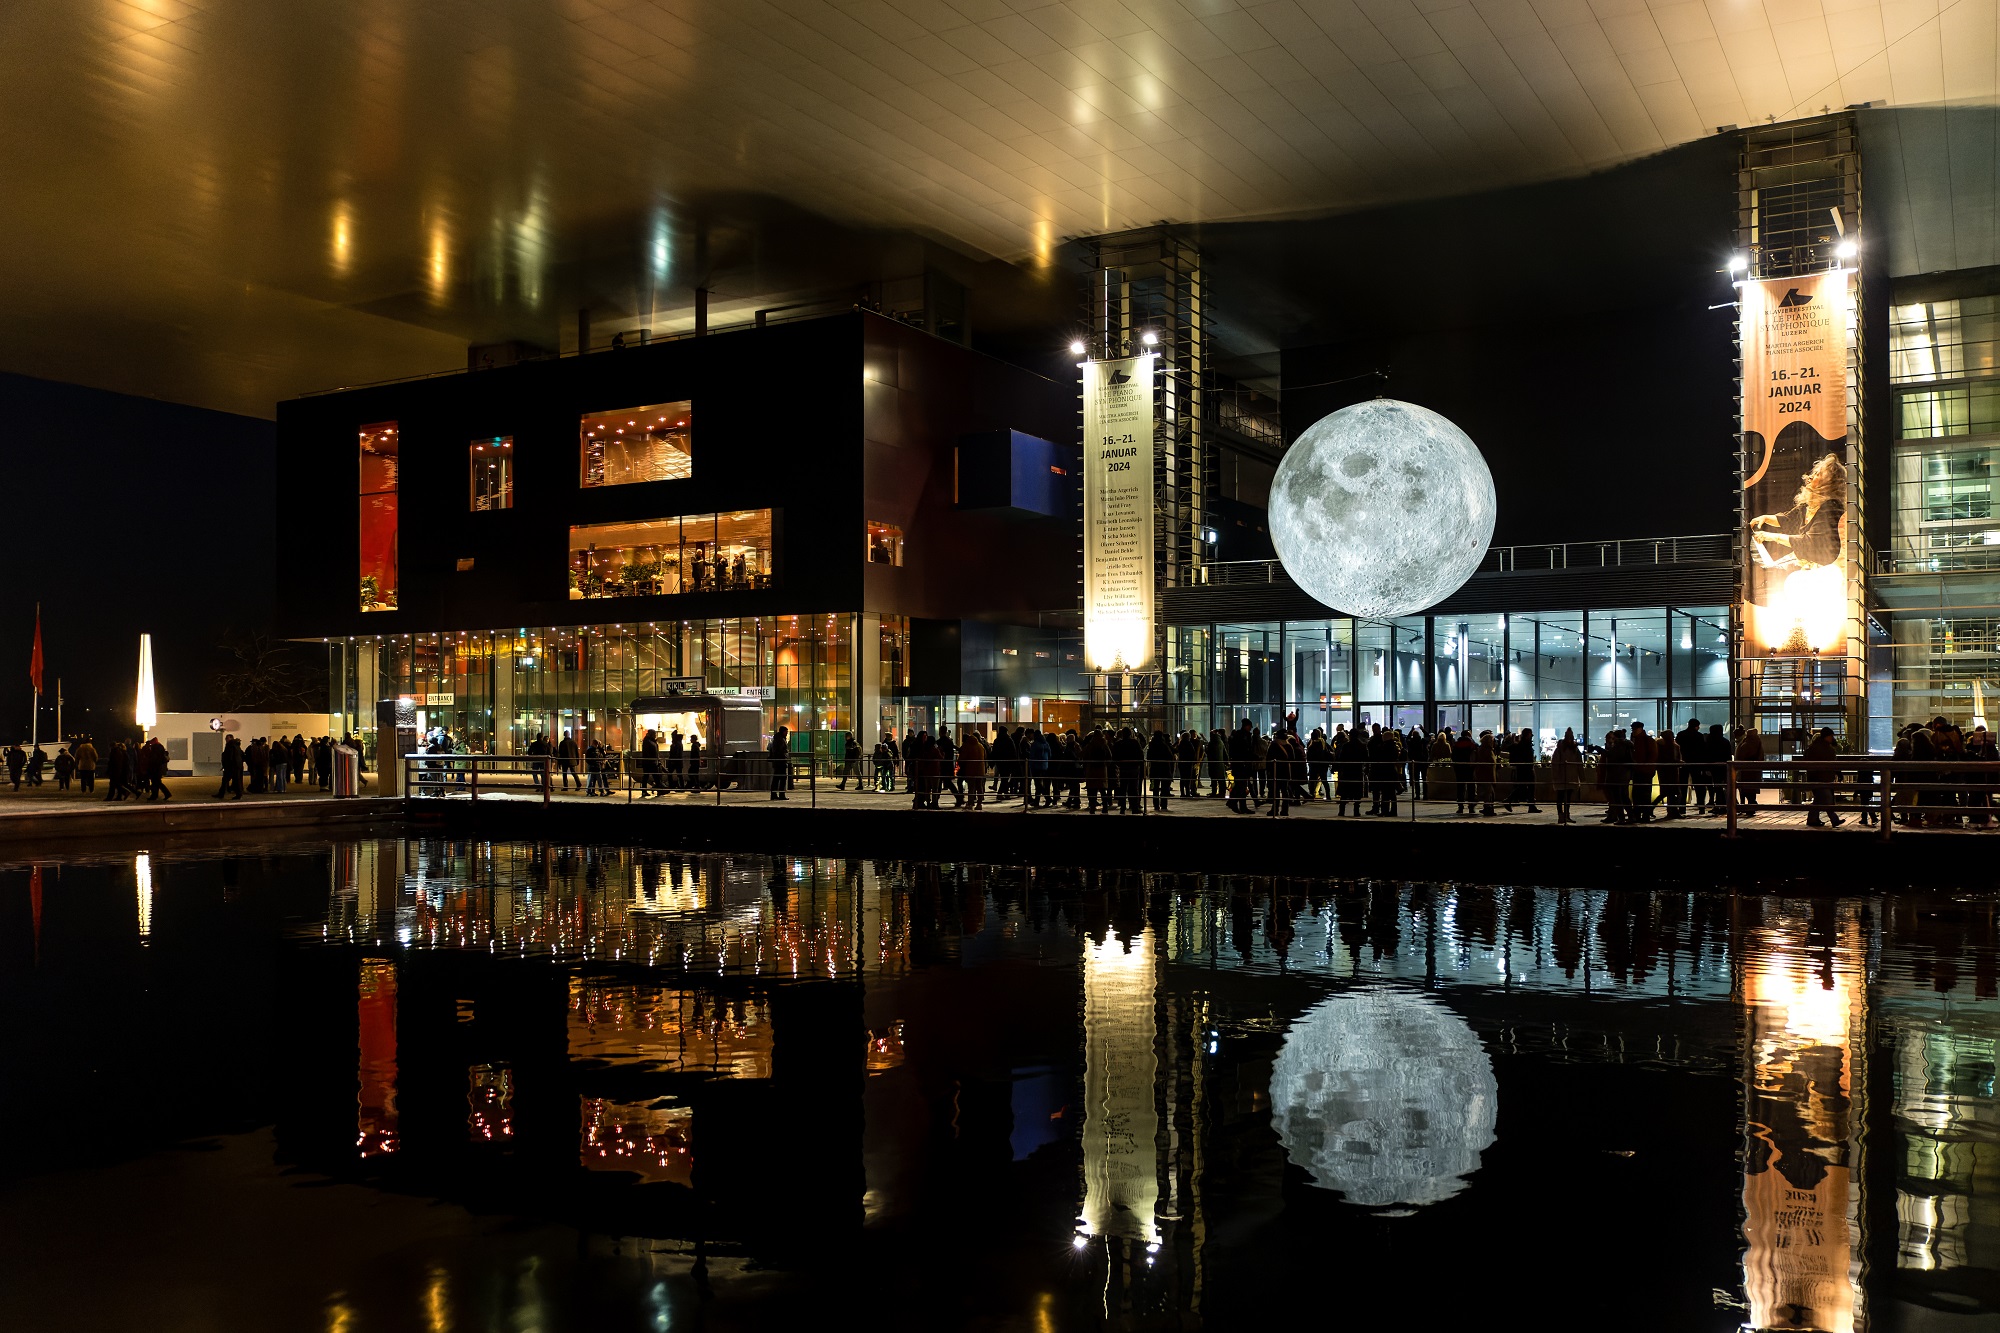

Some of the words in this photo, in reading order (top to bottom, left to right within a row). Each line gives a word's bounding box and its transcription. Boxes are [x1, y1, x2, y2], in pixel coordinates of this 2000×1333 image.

[1773, 315, 1784, 323] LE
[1786, 312, 1816, 322] PIANO
[1760, 318, 1830, 332] SYMPHONIQUE
[1781, 329, 1808, 337] LUZERN
[1793, 339, 1824, 347] ARGERICH
[1113, 389, 1133, 397] PIANO
[1768, 383, 1822, 398] JANUAR
[1778, 400, 1812, 414] 2024
[1100, 447, 1137, 459] JANUAR
[1108, 461, 1131, 472] 2024
[667, 682, 684, 690] KKL
